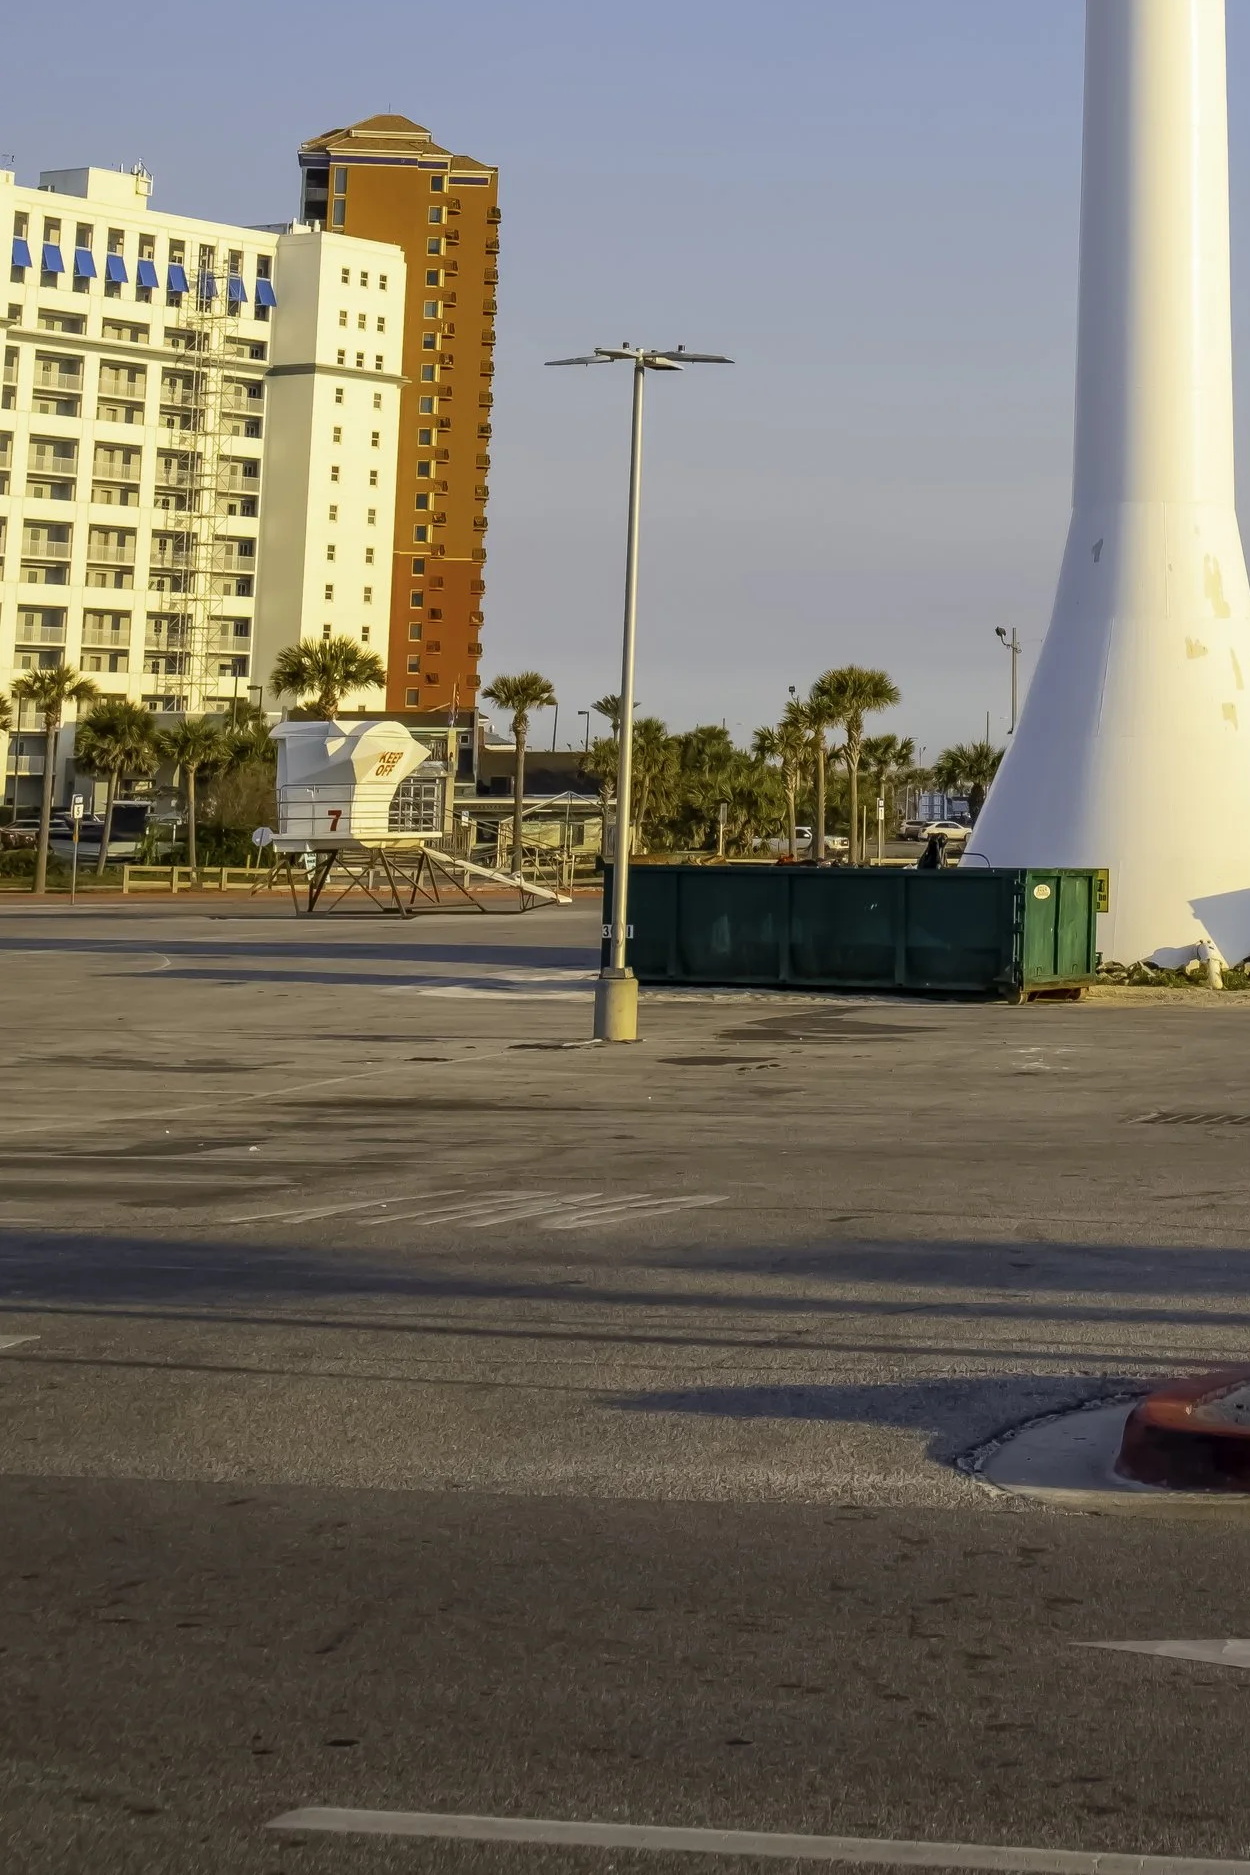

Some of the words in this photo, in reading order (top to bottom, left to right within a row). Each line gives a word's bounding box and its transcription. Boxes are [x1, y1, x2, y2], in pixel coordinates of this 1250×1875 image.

[379, 751, 404, 764] KEEP
[375, 764, 396, 776] OFF
[327, 809, 342, 832] 7
